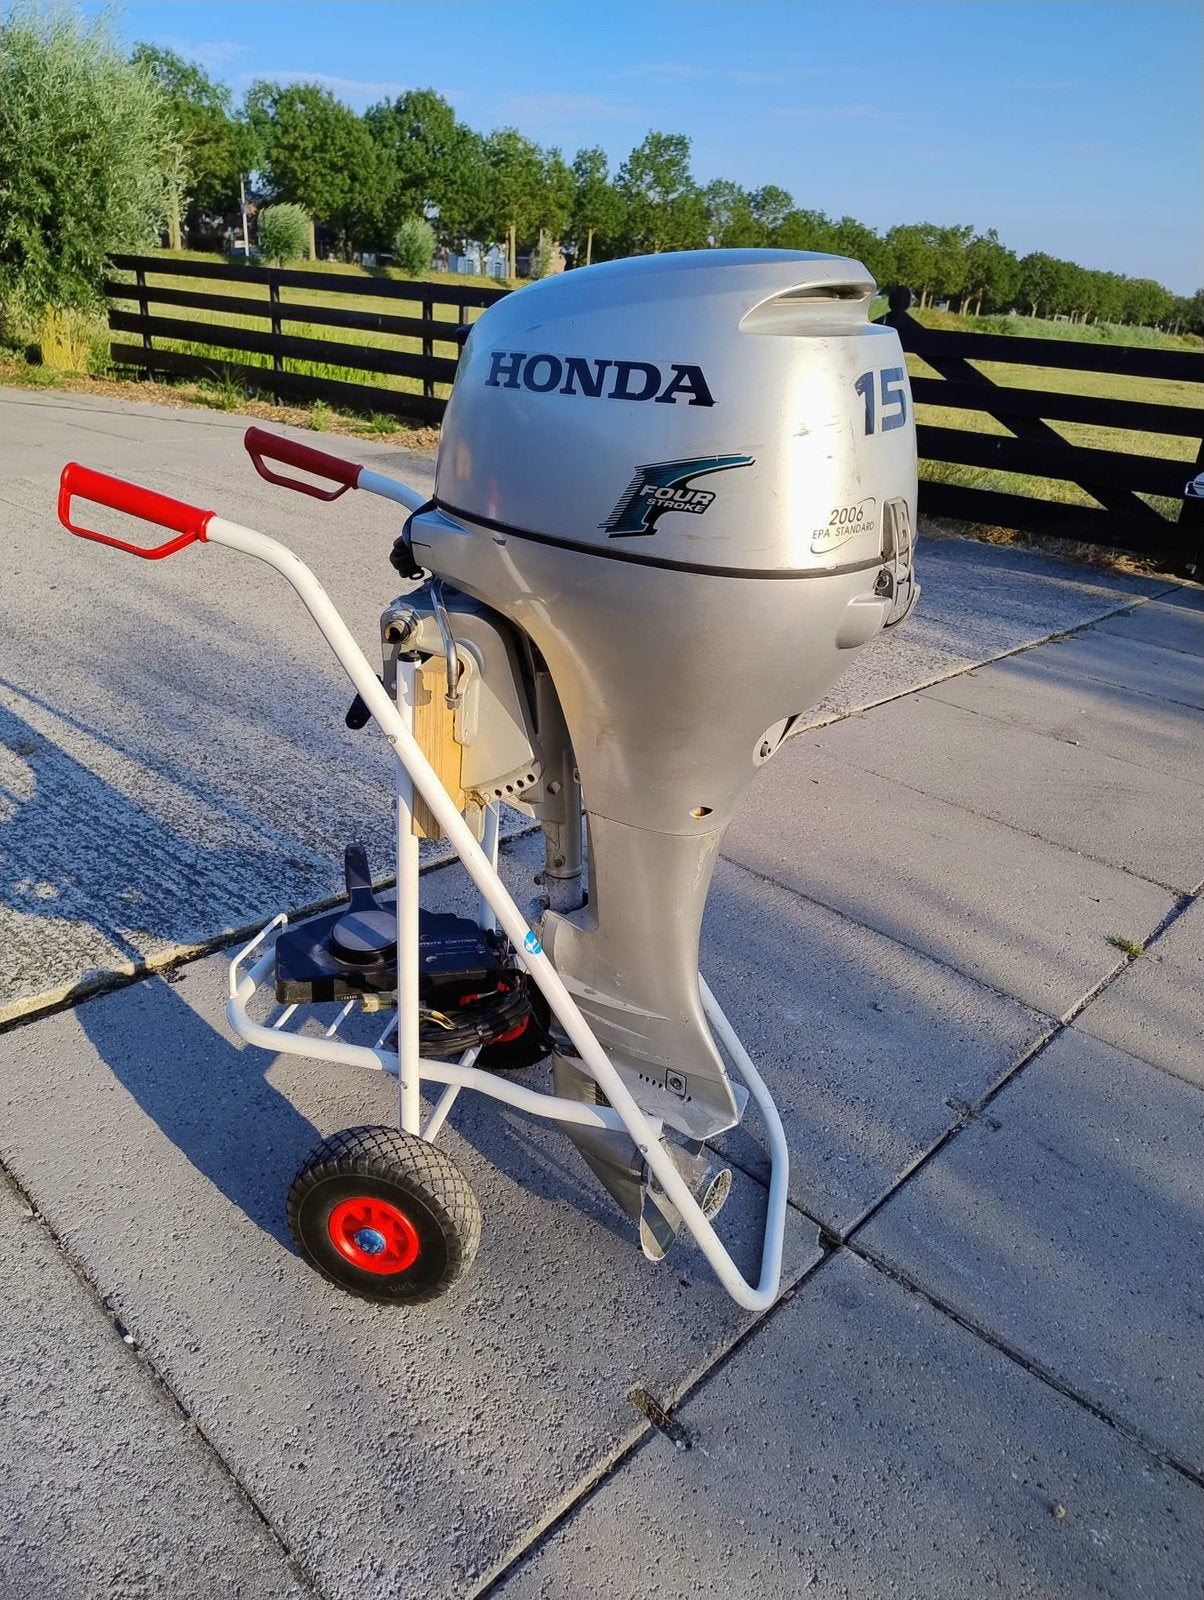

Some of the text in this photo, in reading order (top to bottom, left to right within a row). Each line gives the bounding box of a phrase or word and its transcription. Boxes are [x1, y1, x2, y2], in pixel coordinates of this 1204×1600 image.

[485, 351, 719, 408] HONDA
[854, 366, 907, 436] 15
[640, 484, 714, 505] FOUR
[646, 498, 706, 513] STROKE
[828, 506, 864, 526] 2006
[812, 521, 875, 540] EPA STANDARD
